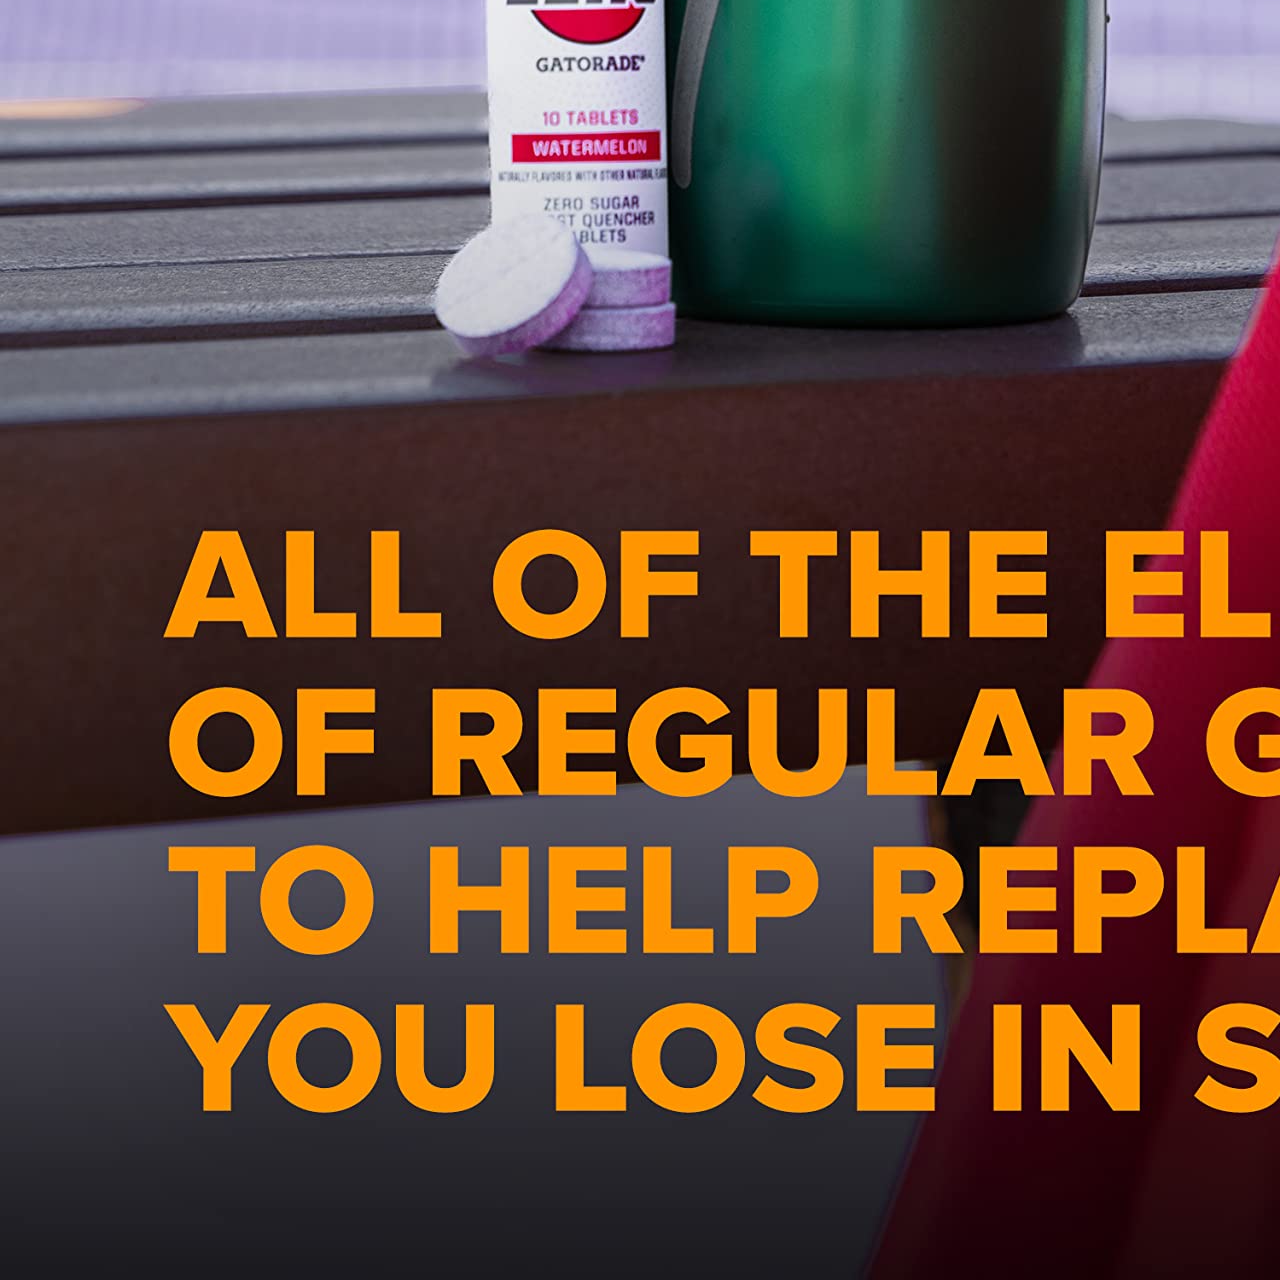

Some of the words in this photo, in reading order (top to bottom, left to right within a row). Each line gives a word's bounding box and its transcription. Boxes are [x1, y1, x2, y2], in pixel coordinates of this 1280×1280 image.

[543, 111, 561, 126] 10
[566, 109, 639, 126] TABLETS
[532, 138, 647, 157] WATERMELON
[543, 197, 583, 212] ZERO
[590, 195, 640, 210] SUGAR
[582, 211, 655, 228] QUENCHER
[579, 228, 627, 244] BLETS
